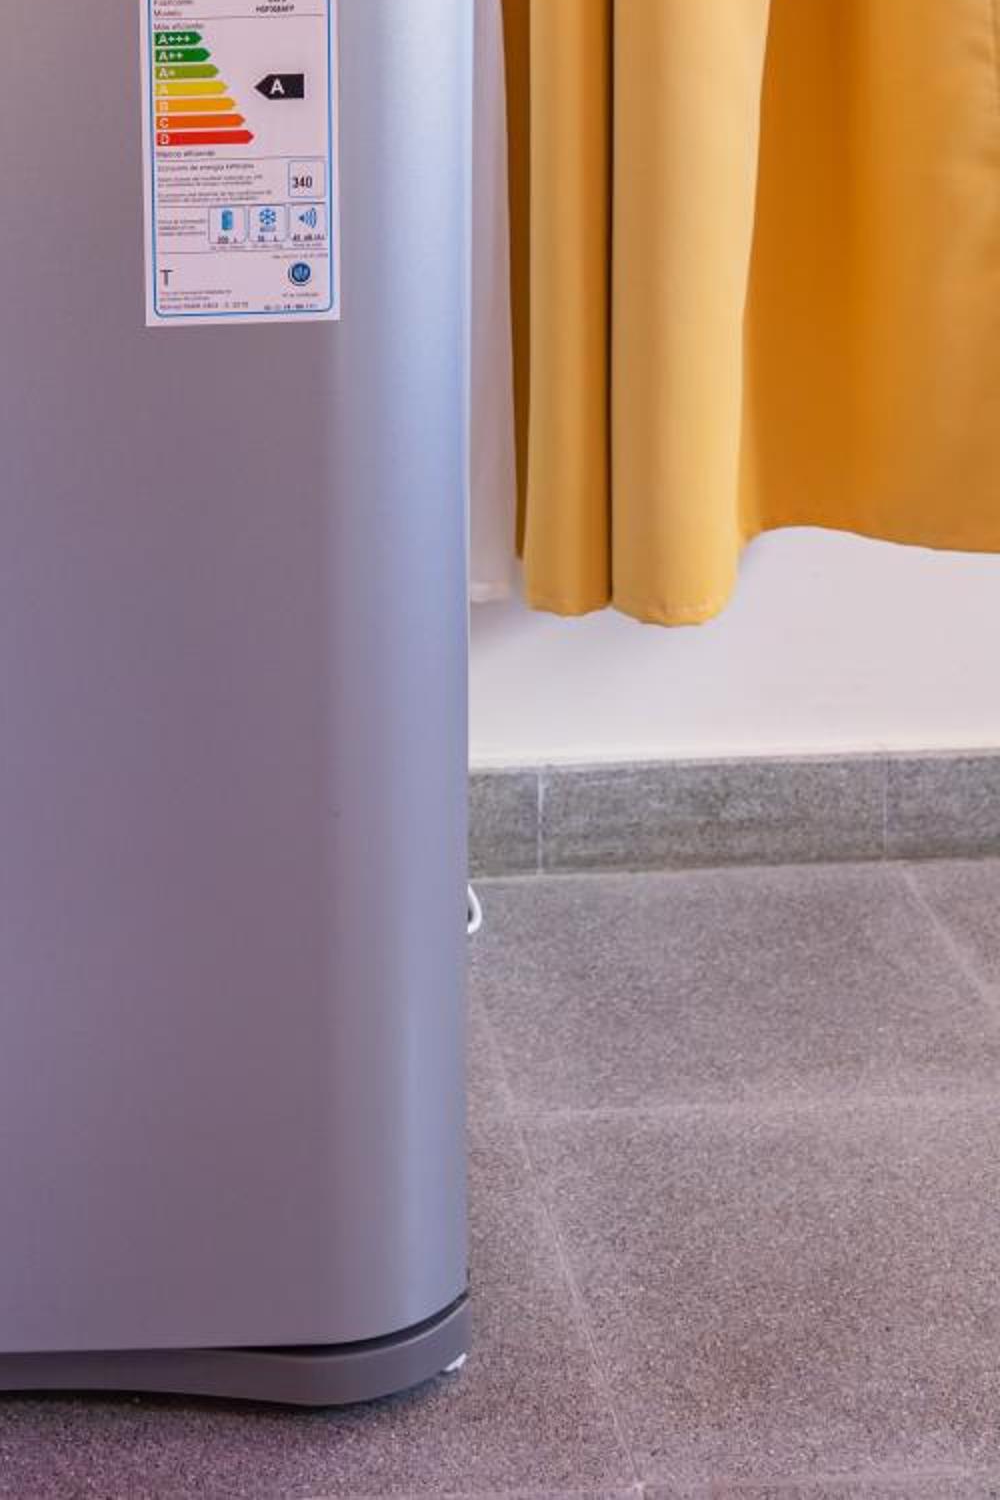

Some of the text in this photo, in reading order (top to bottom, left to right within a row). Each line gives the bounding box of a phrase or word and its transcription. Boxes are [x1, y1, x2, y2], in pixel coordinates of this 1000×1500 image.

[158, 33, 191, 45] A+++
[158, 50, 184, 62] A++
[269, 78, 285, 95] A
[159, 133, 170, 145] D
[291, 176, 313, 189] 340
[159, 269, 174, 287] T
